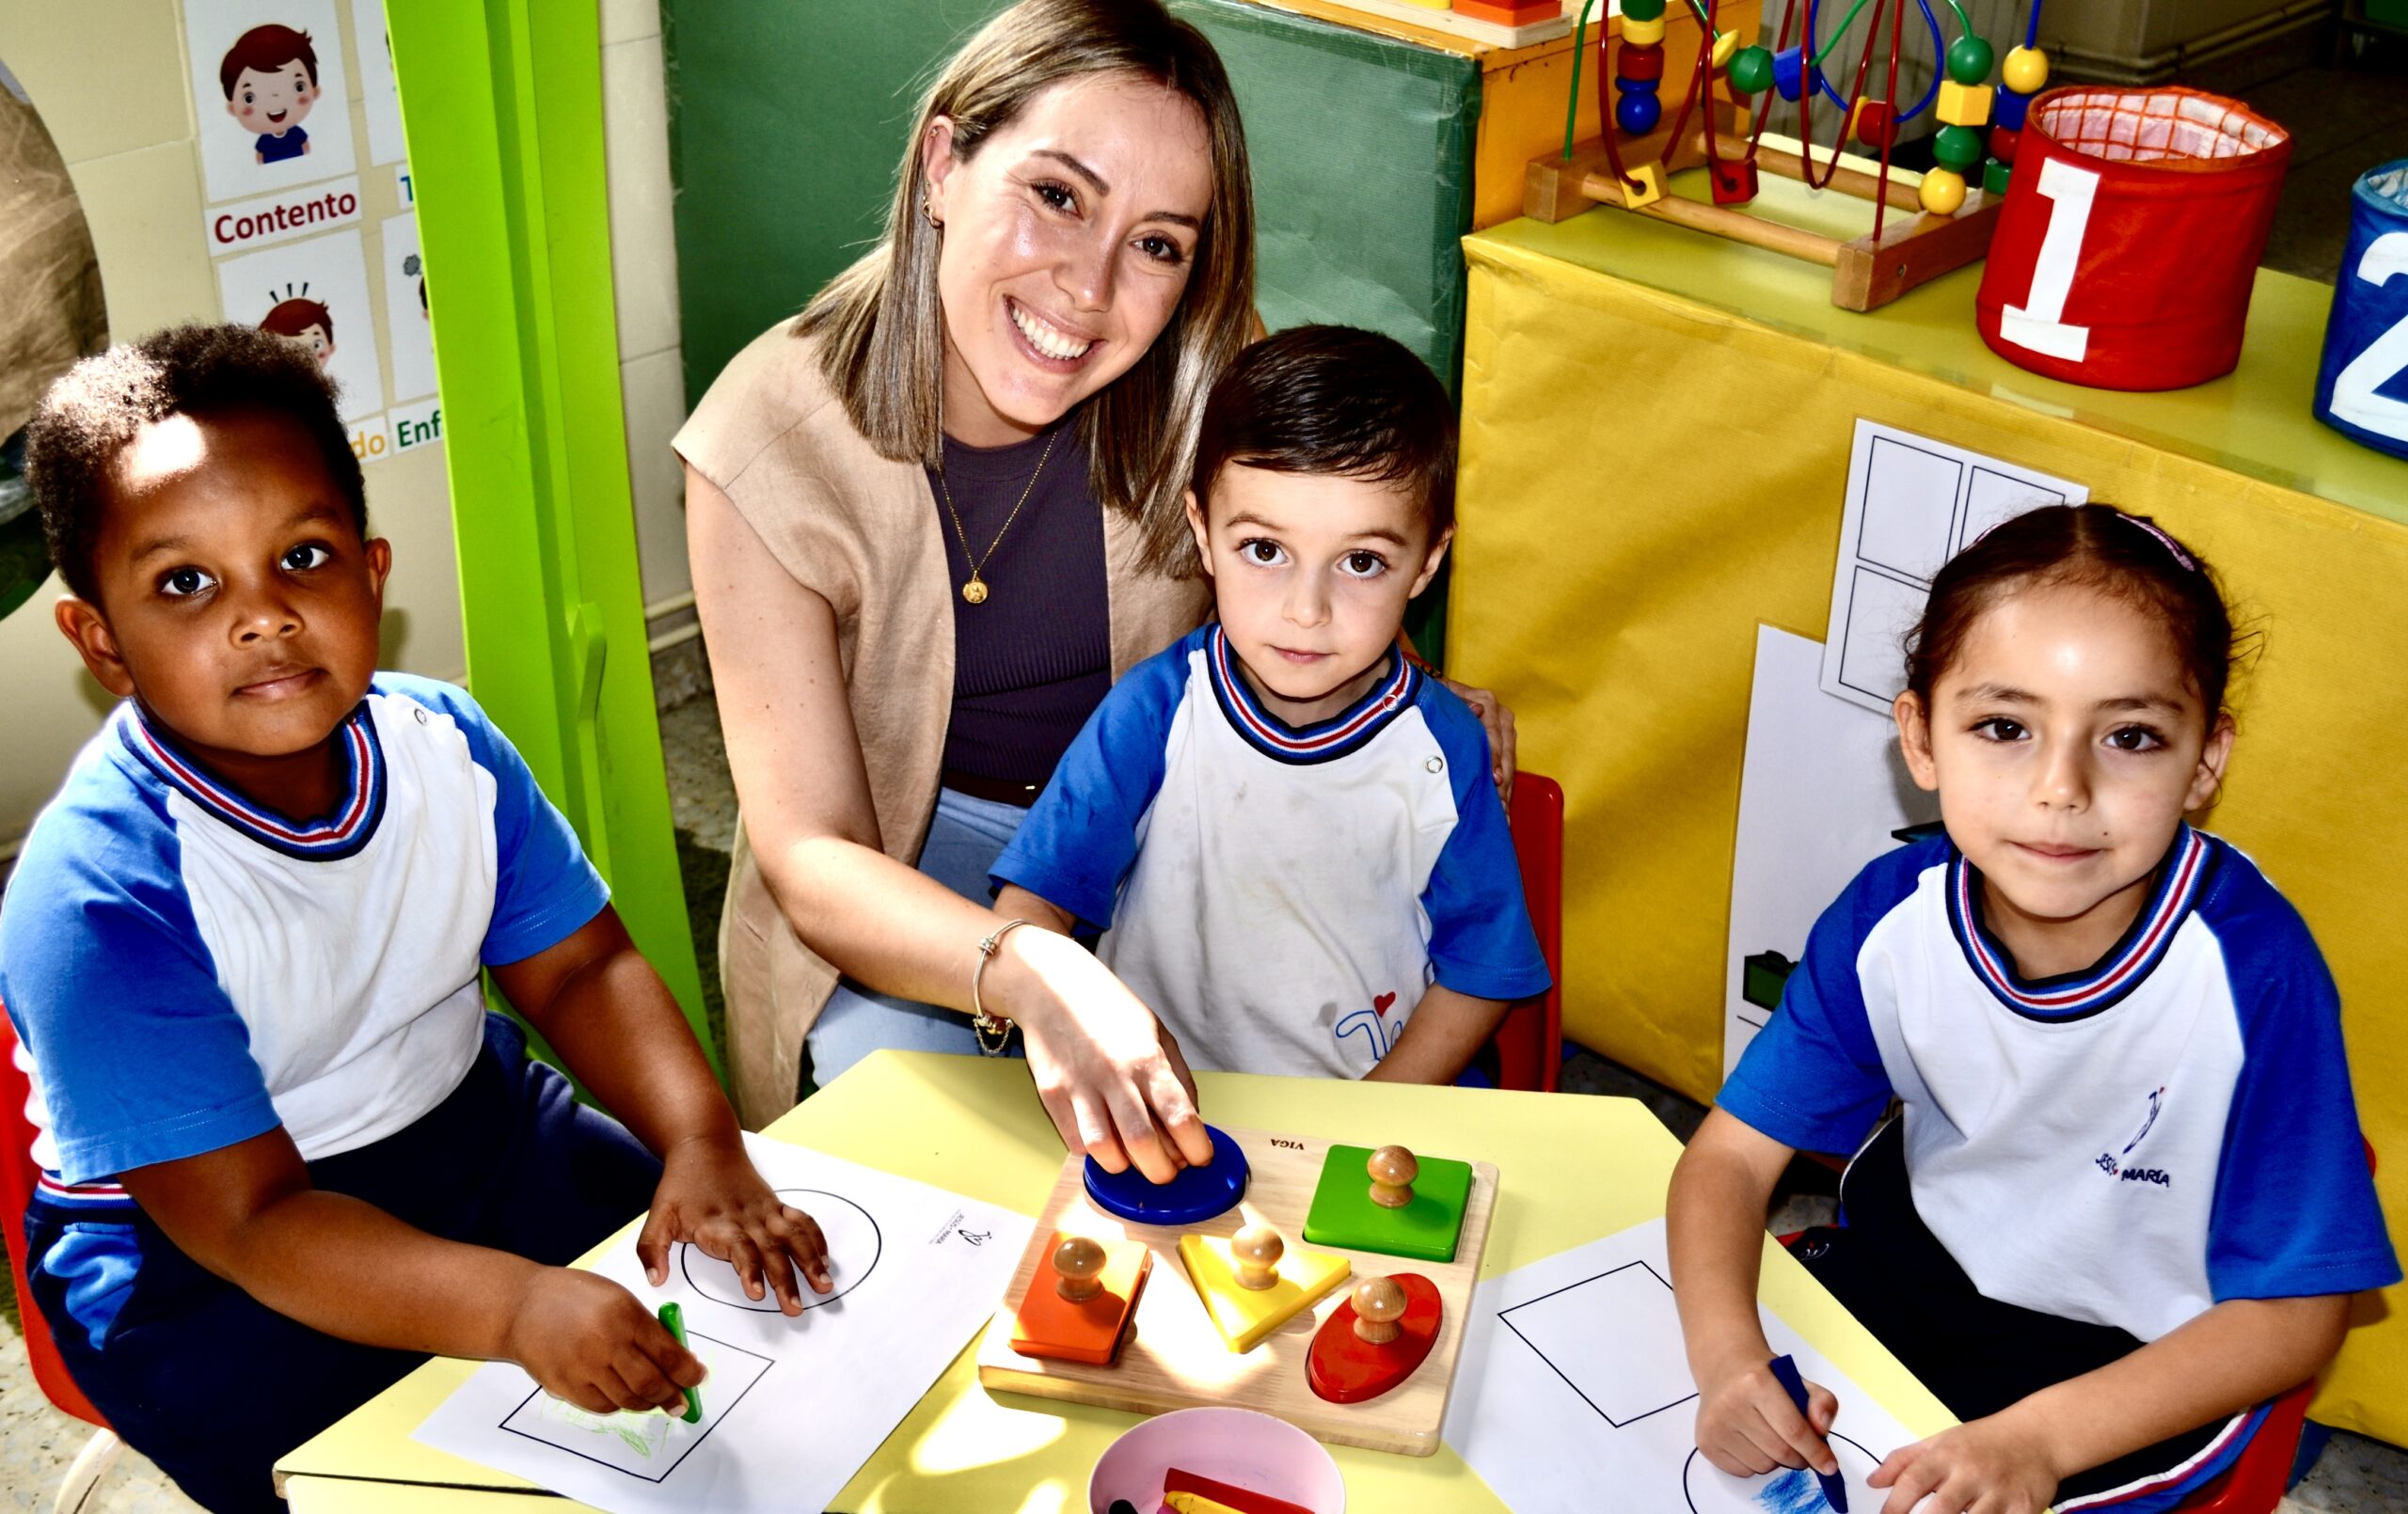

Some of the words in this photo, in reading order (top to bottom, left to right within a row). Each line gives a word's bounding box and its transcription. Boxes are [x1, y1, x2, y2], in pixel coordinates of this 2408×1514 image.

[214, 193, 356, 244] Contento
[2000, 156, 2100, 363] 1
[2329, 230, 2408, 442] 2
[1270, 1138, 1305, 1150] VIGA
